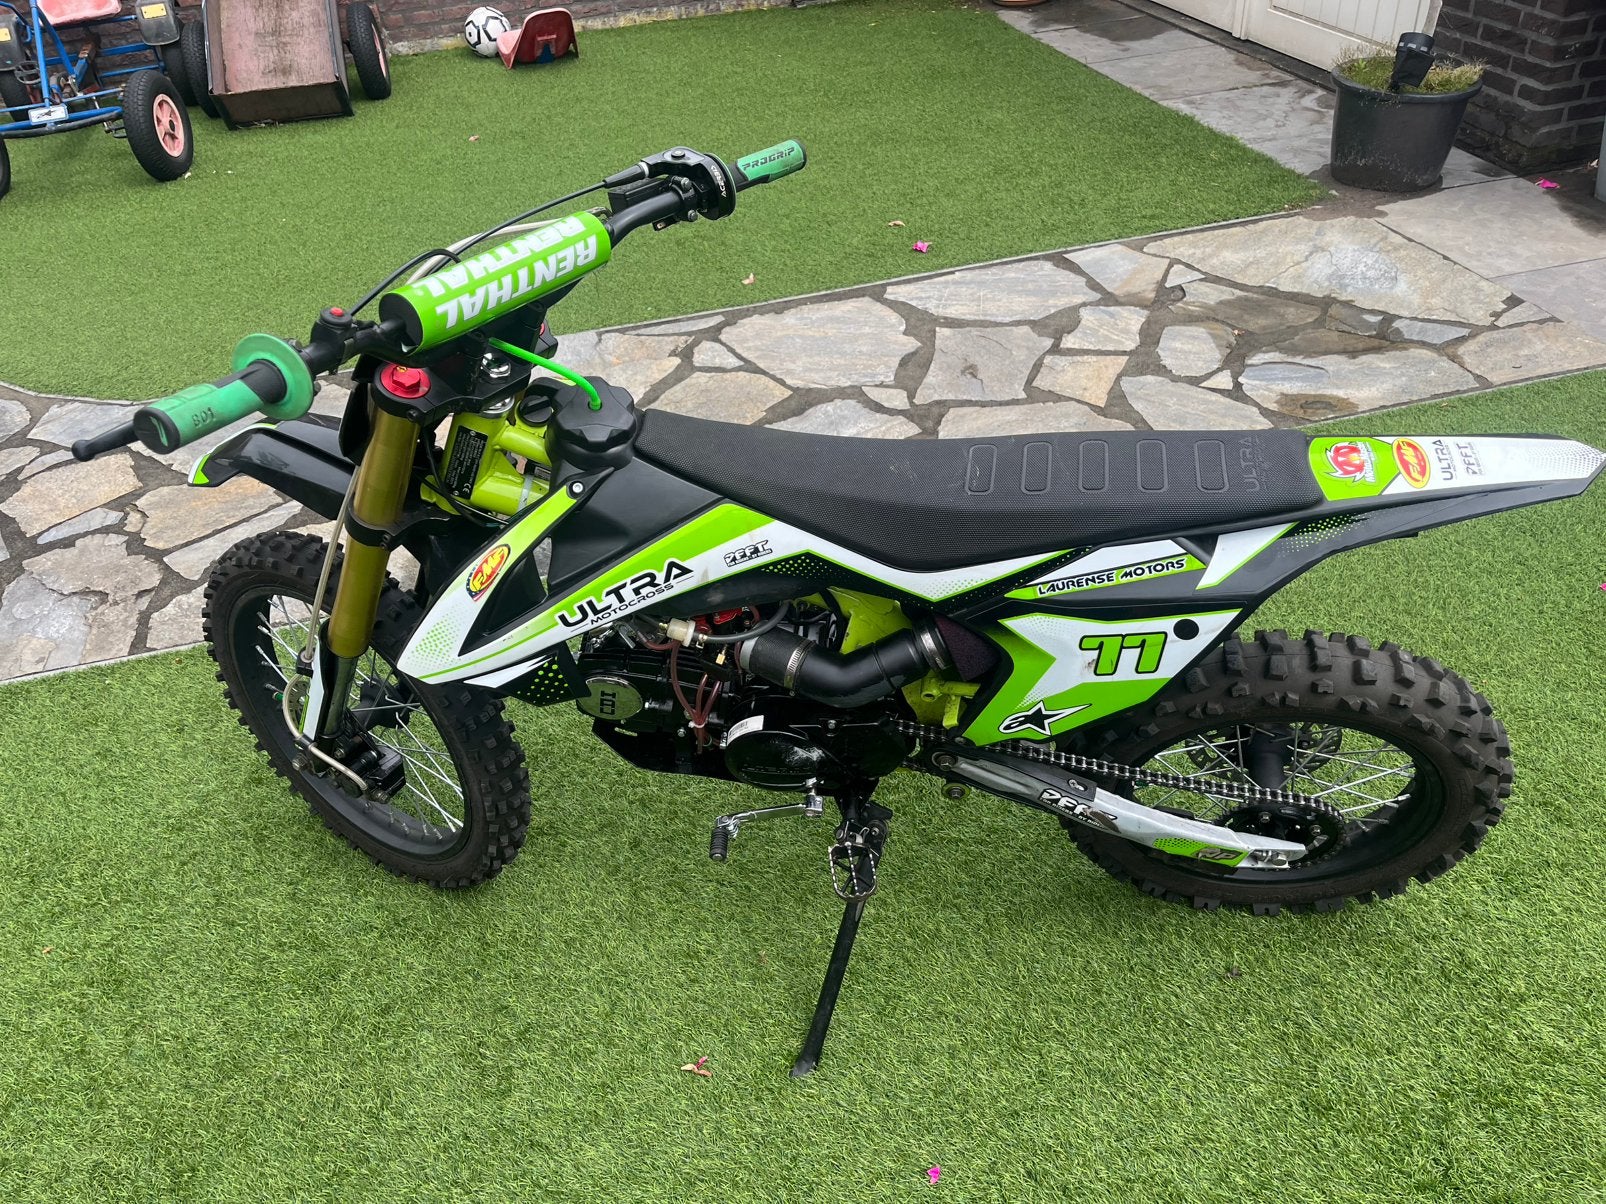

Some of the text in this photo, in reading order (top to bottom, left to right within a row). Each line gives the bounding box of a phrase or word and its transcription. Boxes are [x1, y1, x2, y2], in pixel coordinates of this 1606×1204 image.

[435, 234, 598, 329] RENTHAL
[1432, 439, 1454, 481] ULTRA
[471, 548, 505, 591] FMF
[1038, 559, 1186, 596] LAURENSE MOTORS
[557, 560, 694, 628] ULTRA
[590, 583, 675, 625] MOTOCROSS
[1079, 631, 1168, 676] 77
